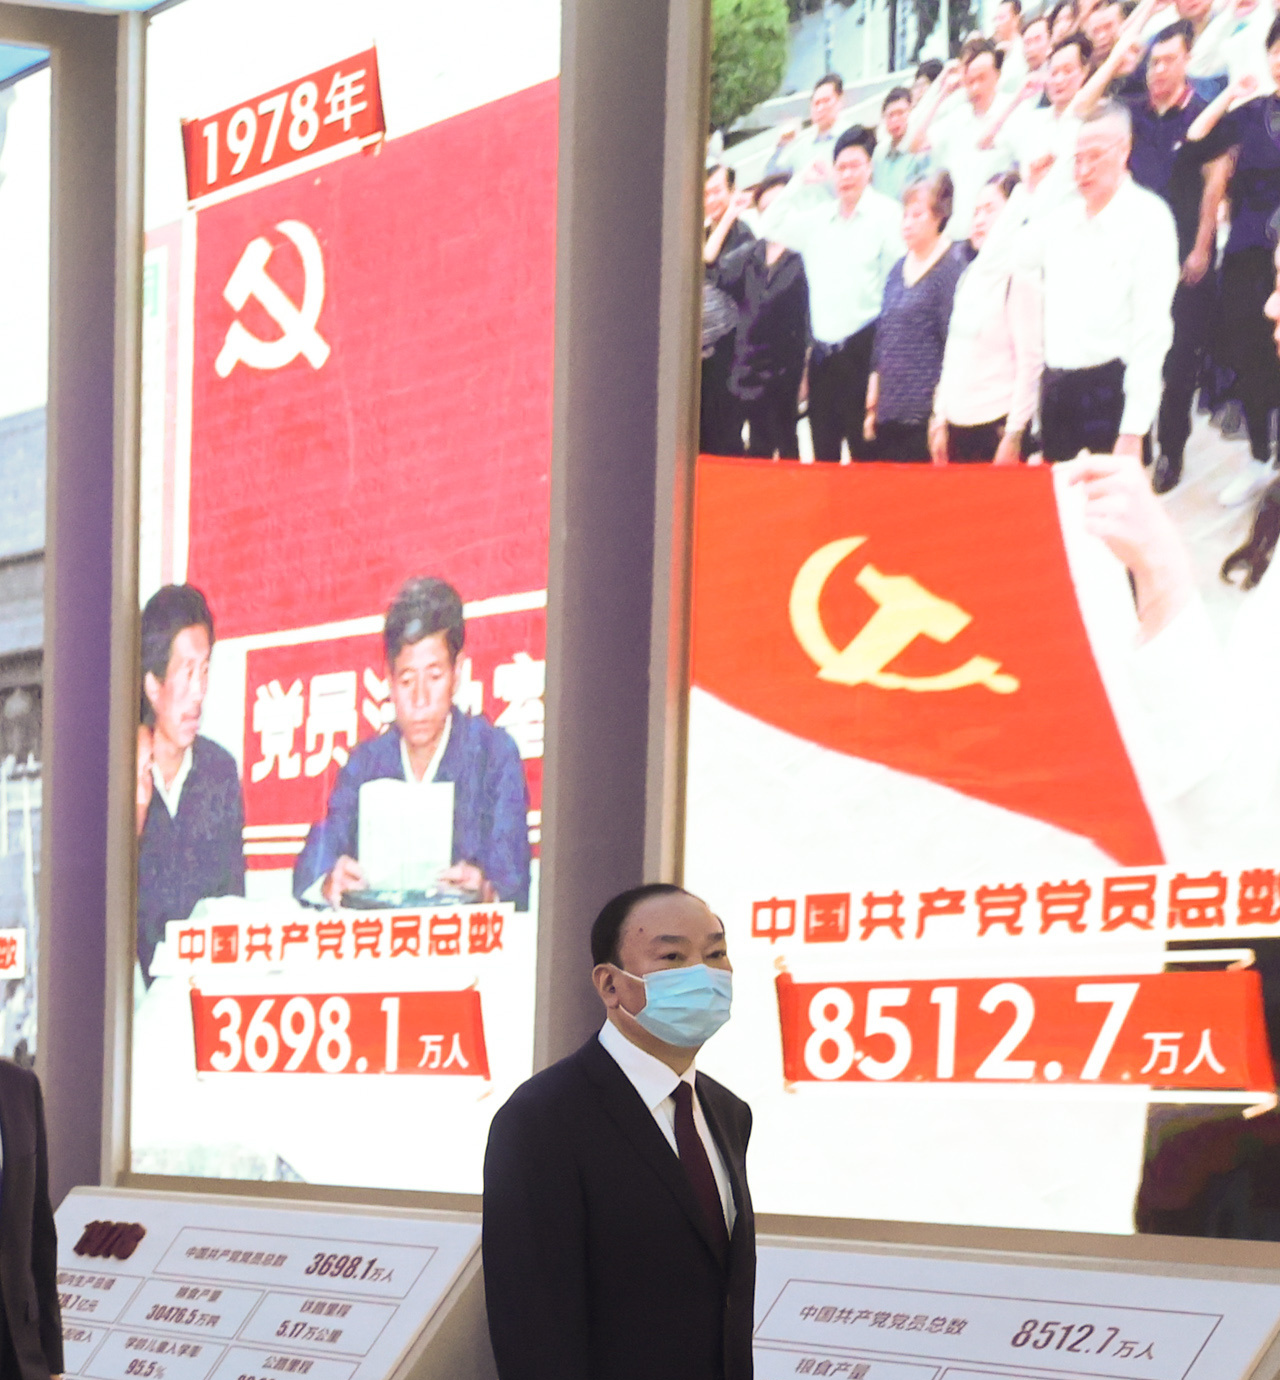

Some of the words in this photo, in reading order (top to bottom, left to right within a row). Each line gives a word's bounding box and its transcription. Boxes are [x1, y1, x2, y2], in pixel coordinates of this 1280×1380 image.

[201, 66, 369, 185] 1978年
[251, 652, 546, 782] 党员室
[178, 910, 504, 964] 中国共产党党员总数
[751, 868, 1280, 944] 中国共产党党员总数
[799, 1304, 969, 1336] 中国共产党党员总数
